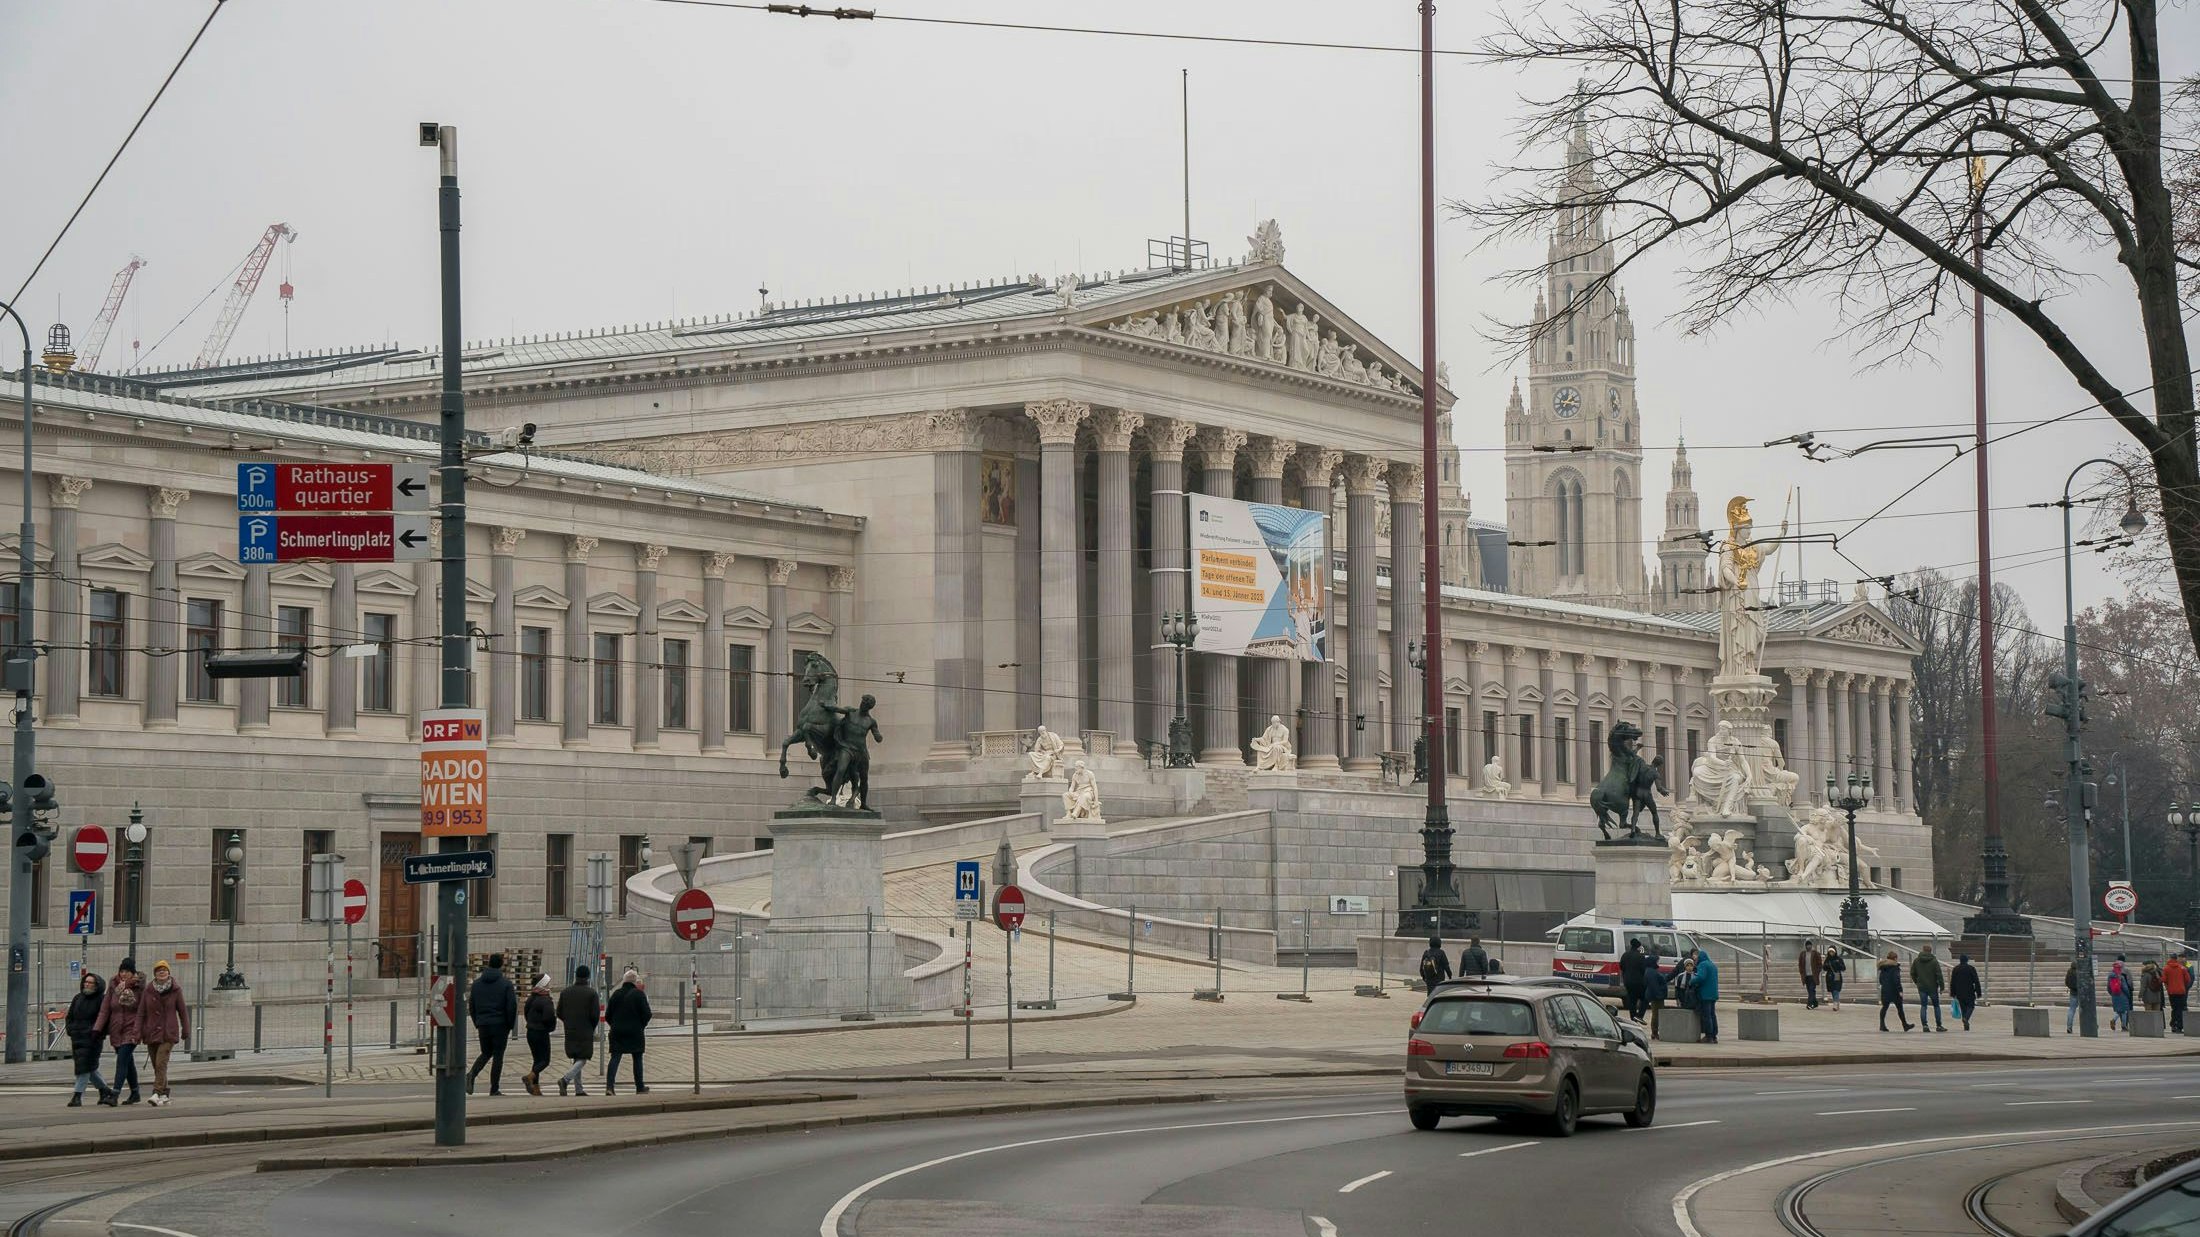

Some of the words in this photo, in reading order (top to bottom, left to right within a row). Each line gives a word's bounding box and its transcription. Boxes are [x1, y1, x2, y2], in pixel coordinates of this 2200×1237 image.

[250, 473, 266, 492] P
[291, 467, 377, 484] Rathaus-
[240, 494, 274, 508] 500m
[295, 486, 373, 506] quartier
[251, 525, 267, 545] P
[280, 530, 391, 550] Schmerlingplatz
[243, 546, 273, 561] 380m
[1201, 570, 1214, 580] Tage
[423, 723, 459, 738] ORF
[465, 723, 481, 737] W
[423, 759, 484, 781] RADIO
[422, 783, 483, 807] WIEN
[452, 809, 482, 825] 95.3
[418, 860, 488, 875] chmerlingplatz
